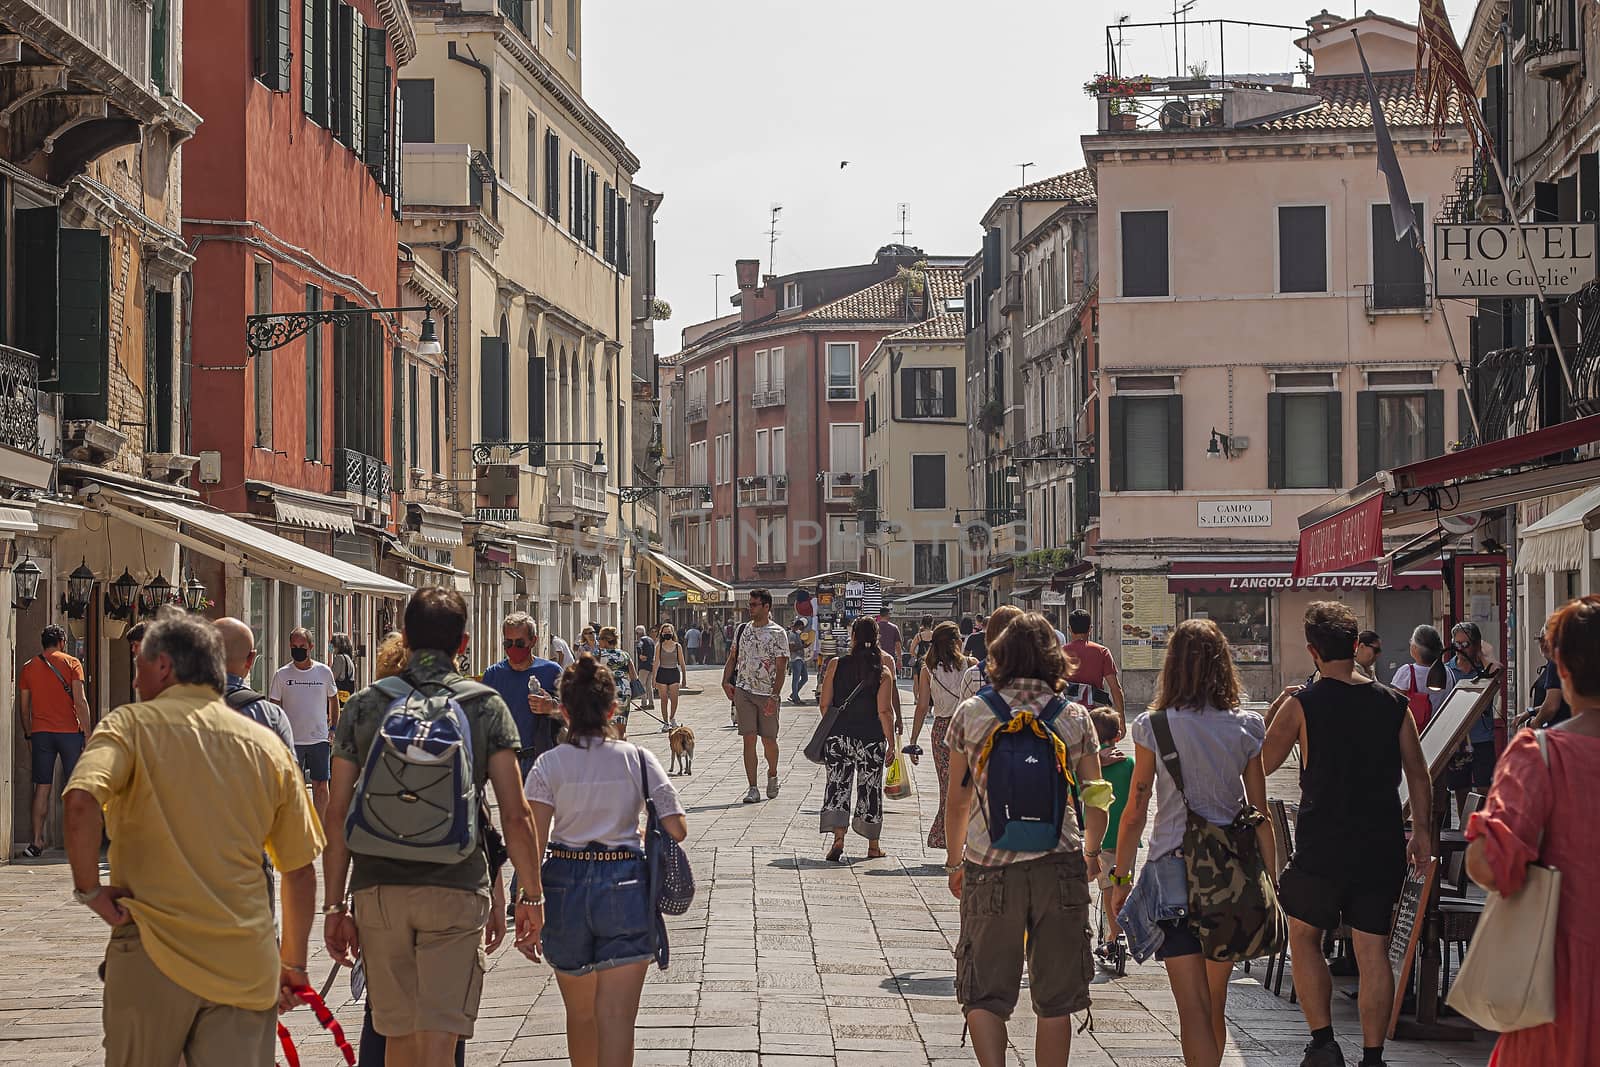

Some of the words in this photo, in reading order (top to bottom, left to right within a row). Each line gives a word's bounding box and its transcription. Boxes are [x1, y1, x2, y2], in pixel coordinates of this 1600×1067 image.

[1441, 227, 1592, 260] HOTEL
[1454, 267, 1499, 287] "Alle
[1506, 267, 1577, 293] Guglie"
[1216, 504, 1252, 513] CAMPO
[476, 509, 518, 520] FARMACIA
[1213, 515, 1269, 523] LEONARDO
[1296, 577, 1338, 587] DELLA
[1342, 576, 1378, 586] PIZZA
